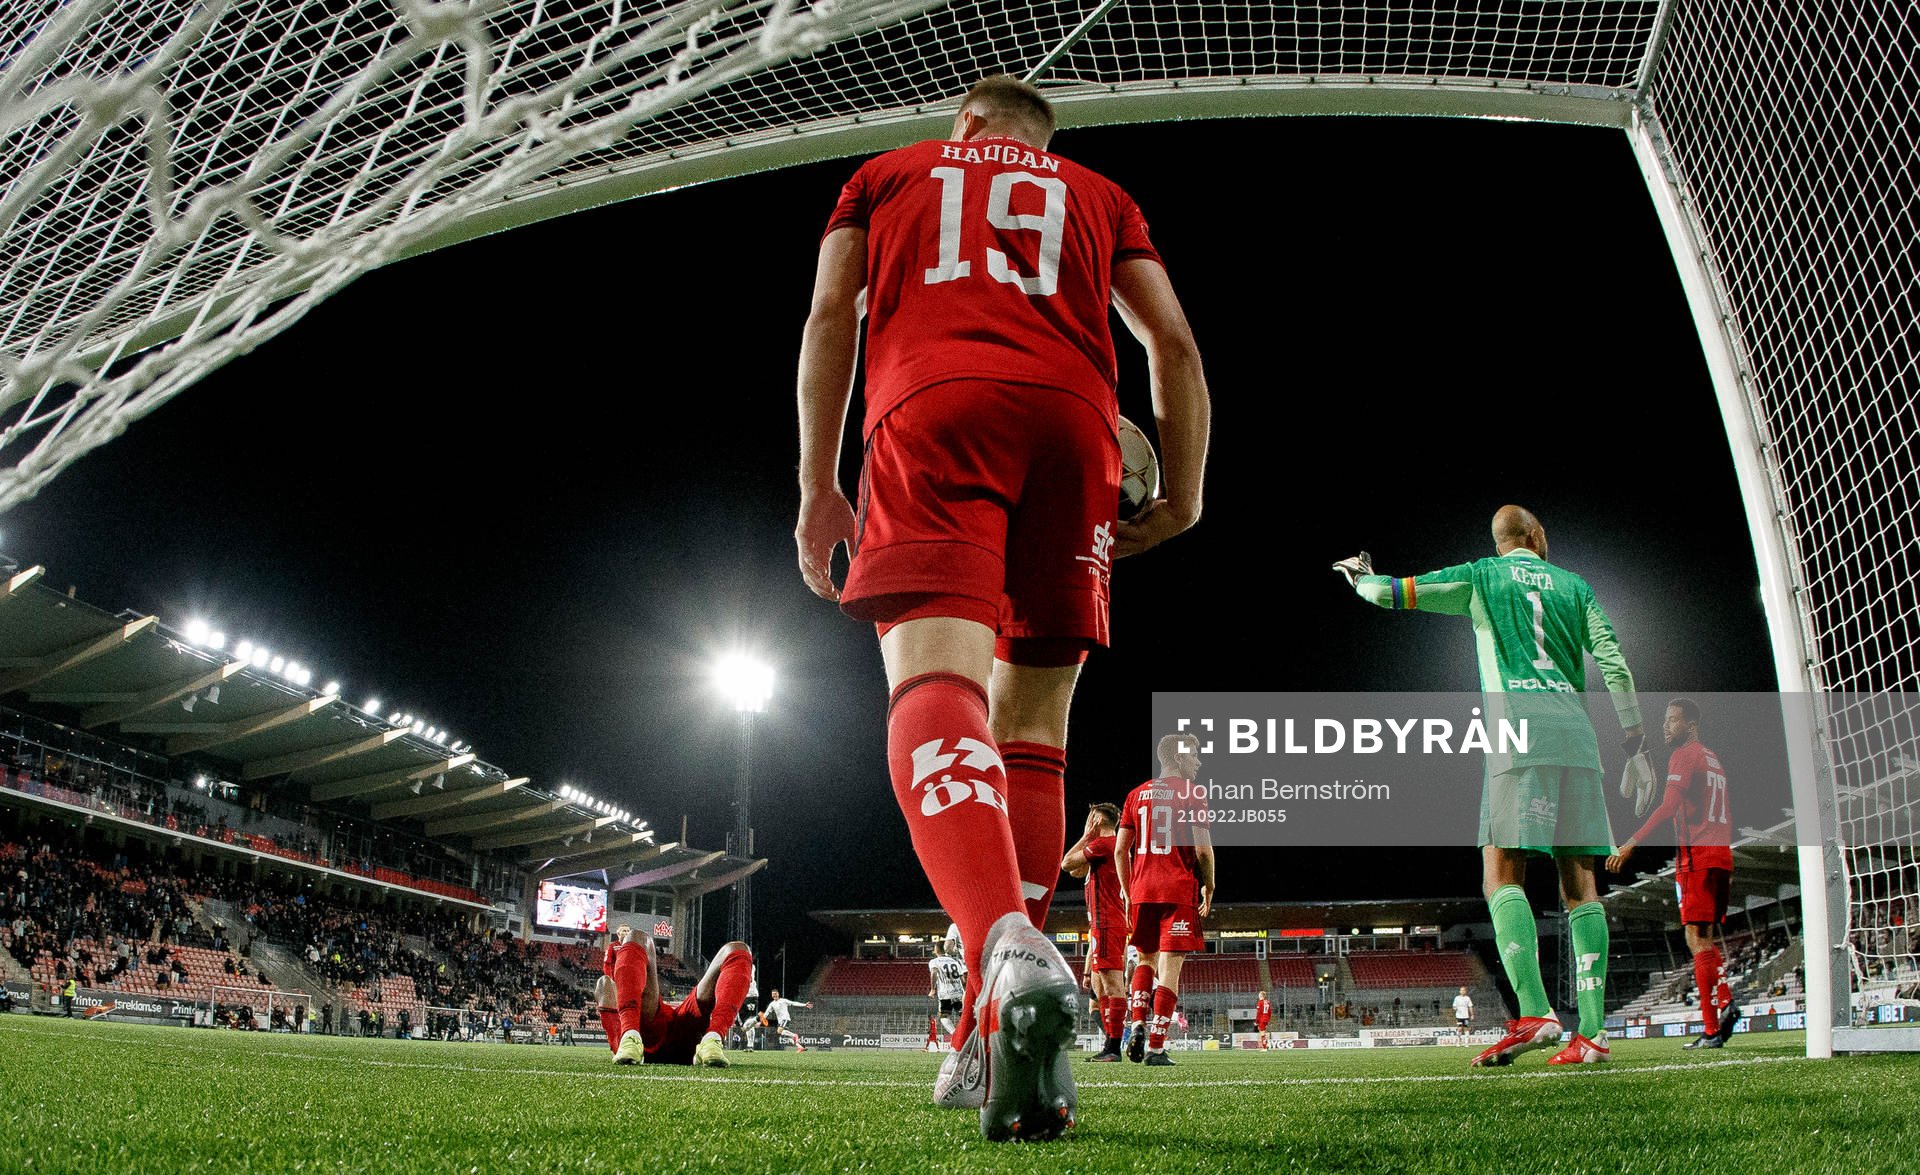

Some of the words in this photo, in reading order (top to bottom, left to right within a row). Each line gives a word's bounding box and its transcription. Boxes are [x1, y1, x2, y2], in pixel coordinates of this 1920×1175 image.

[941, 144, 1061, 172] HAUGAN
[924, 166, 1067, 296] 19
[1526, 591, 1555, 670] 1
[1706, 770, 1728, 824] 77
[1137, 805, 1173, 855] 13
[654, 920, 673, 937] MAX
[943, 963, 960, 979] 18
[843, 1035, 880, 1047] Printoz
